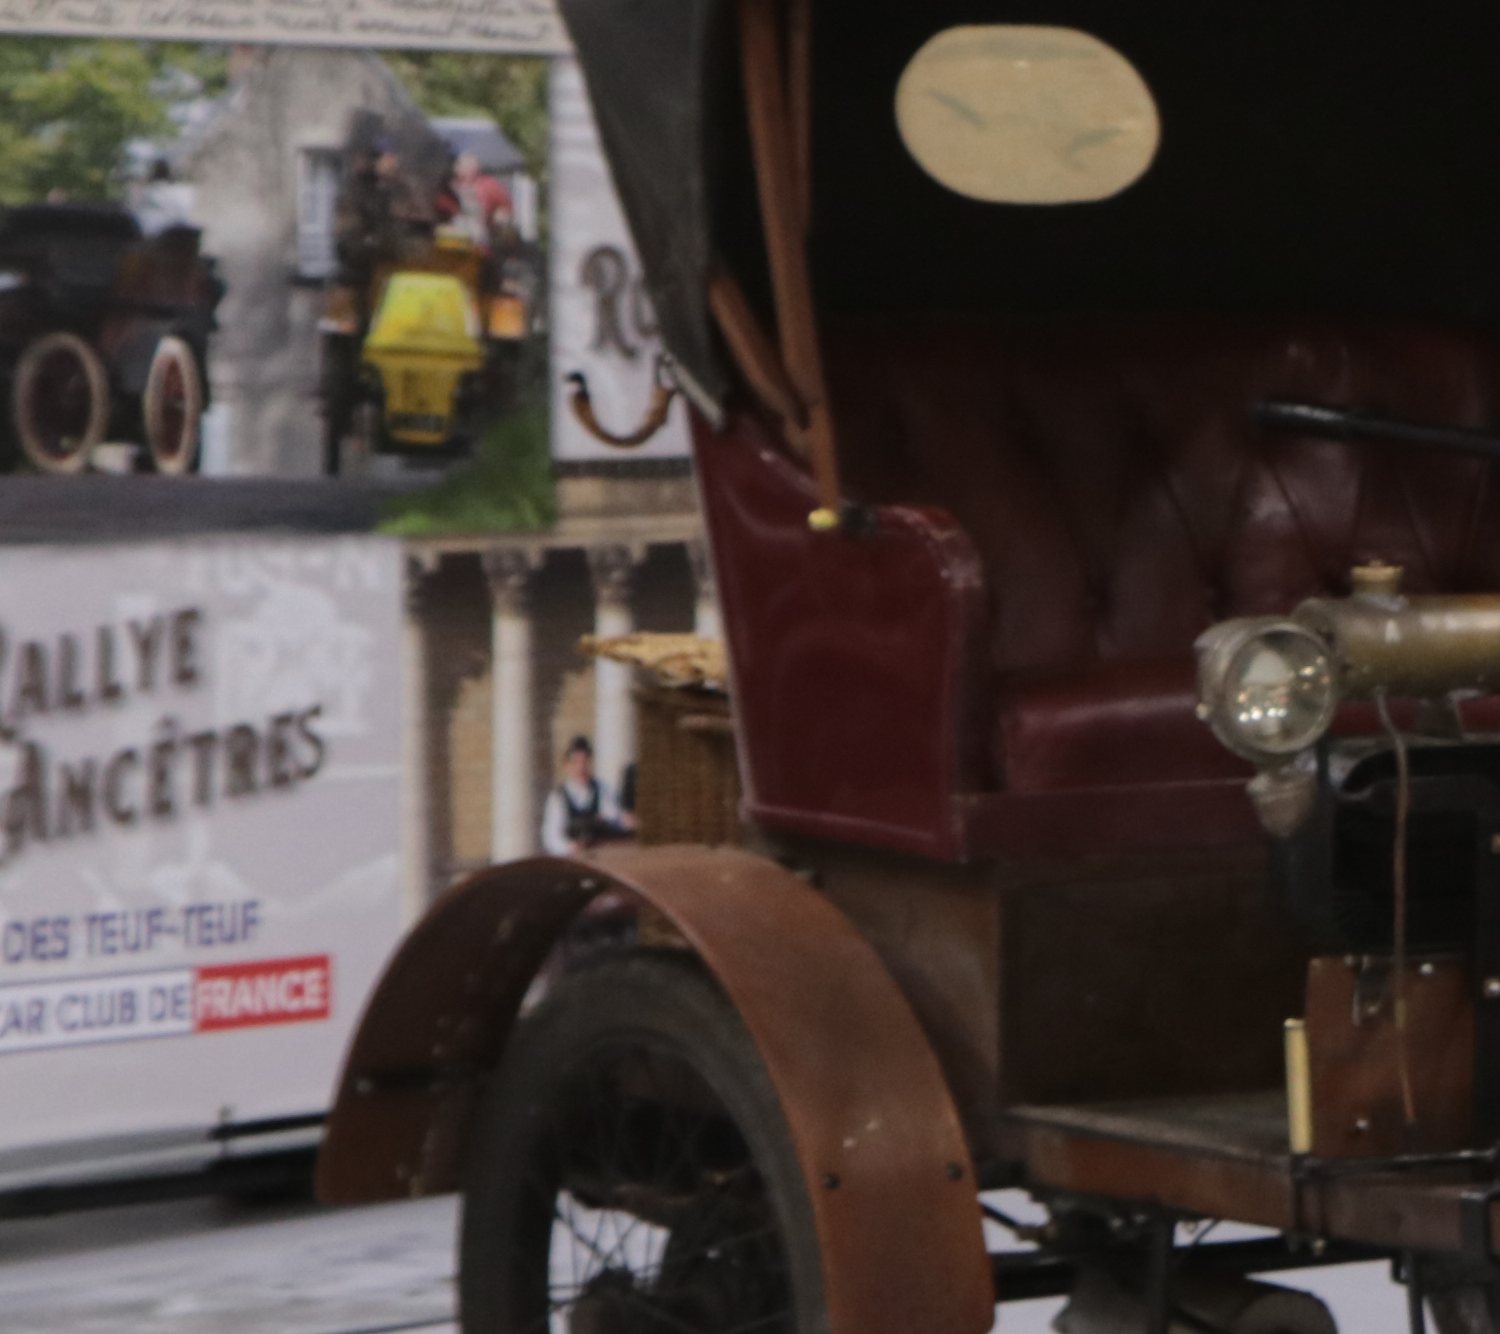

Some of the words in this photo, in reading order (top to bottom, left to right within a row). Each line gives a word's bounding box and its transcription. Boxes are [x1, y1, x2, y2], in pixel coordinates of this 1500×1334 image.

[2, 916, 70, 963] DES
[85, 900, 262, 955] TEUF-TEUF
[0, 995, 46, 1037] AR
[55, 986, 137, 1033] CLUB
[148, 980, 188, 1022] DE
[200, 968, 326, 1021] FRANCE
